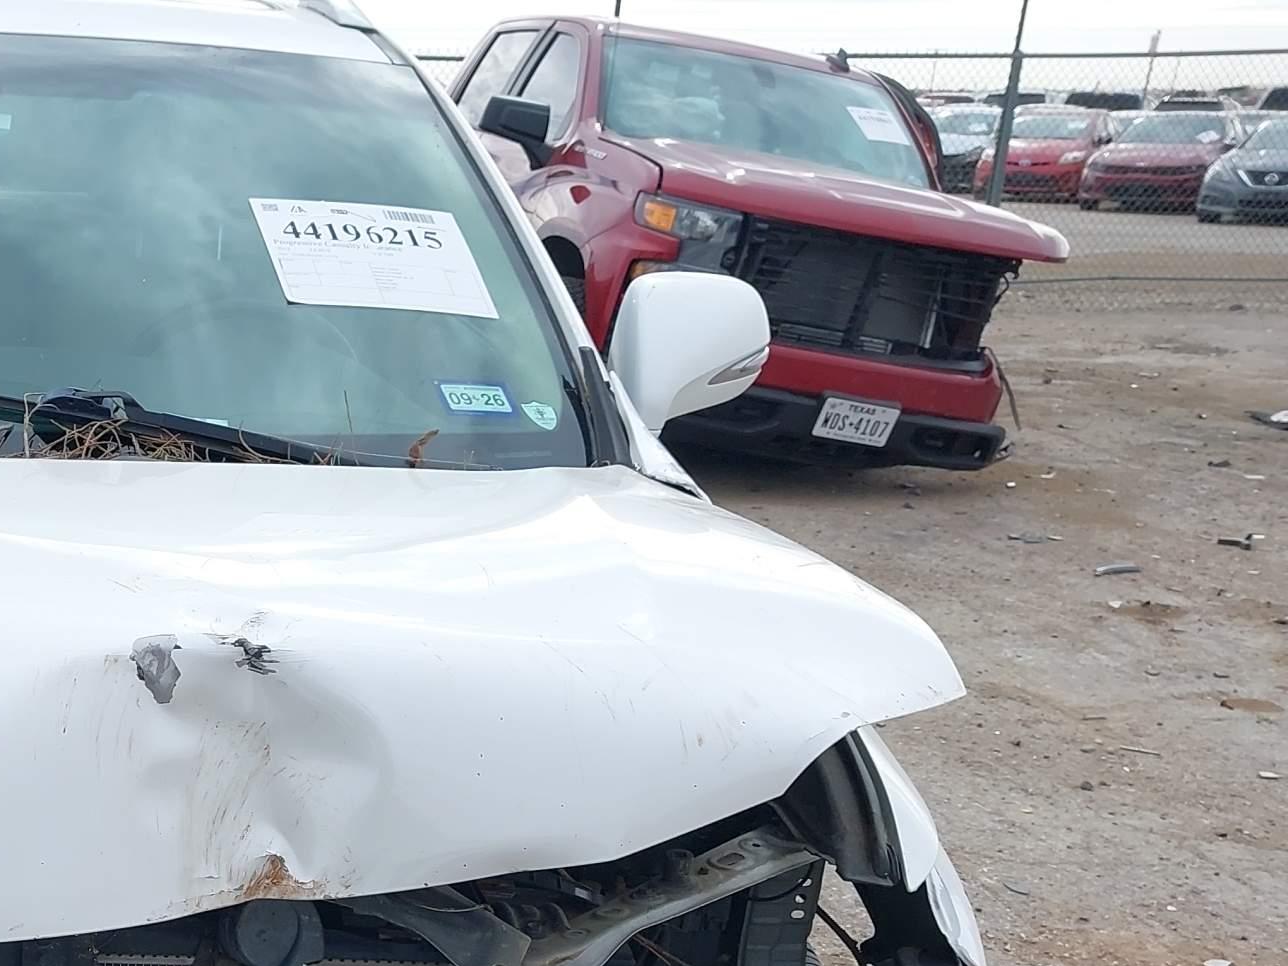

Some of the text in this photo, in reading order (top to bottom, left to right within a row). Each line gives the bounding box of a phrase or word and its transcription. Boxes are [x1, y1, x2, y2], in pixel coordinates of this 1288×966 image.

[283, 219, 443, 249] 44196215
[449, 392, 505, 407] 09 26
[849, 404, 876, 415] TEXAS
